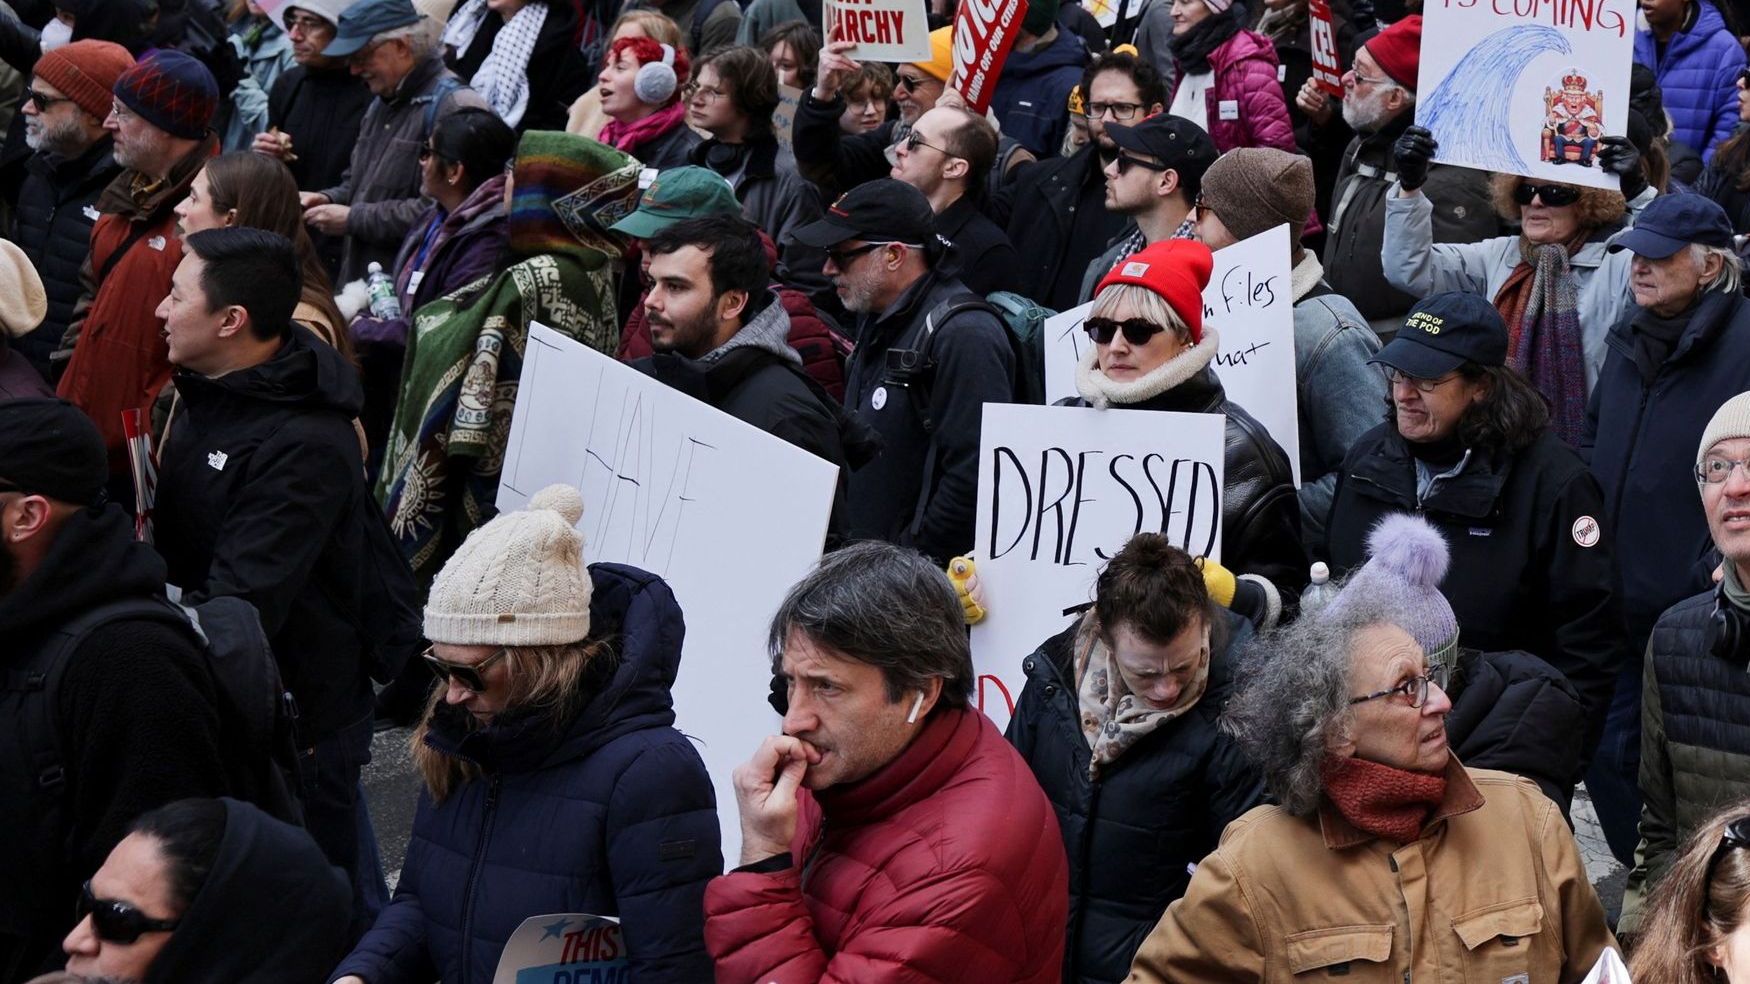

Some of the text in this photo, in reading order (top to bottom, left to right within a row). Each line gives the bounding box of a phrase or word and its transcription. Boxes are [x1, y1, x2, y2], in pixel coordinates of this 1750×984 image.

[989, 22, 1005, 53] OUR
[979, 50, 994, 72] OFF
[966, 71, 986, 105] HANDS
[1418, 322, 1441, 336] POD
[1431, 317, 1444, 327] OF
[989, 445, 1220, 568] DRESSED
[1575, 522, 1596, 541] TRUMP
[559, 924, 620, 967] THIS
